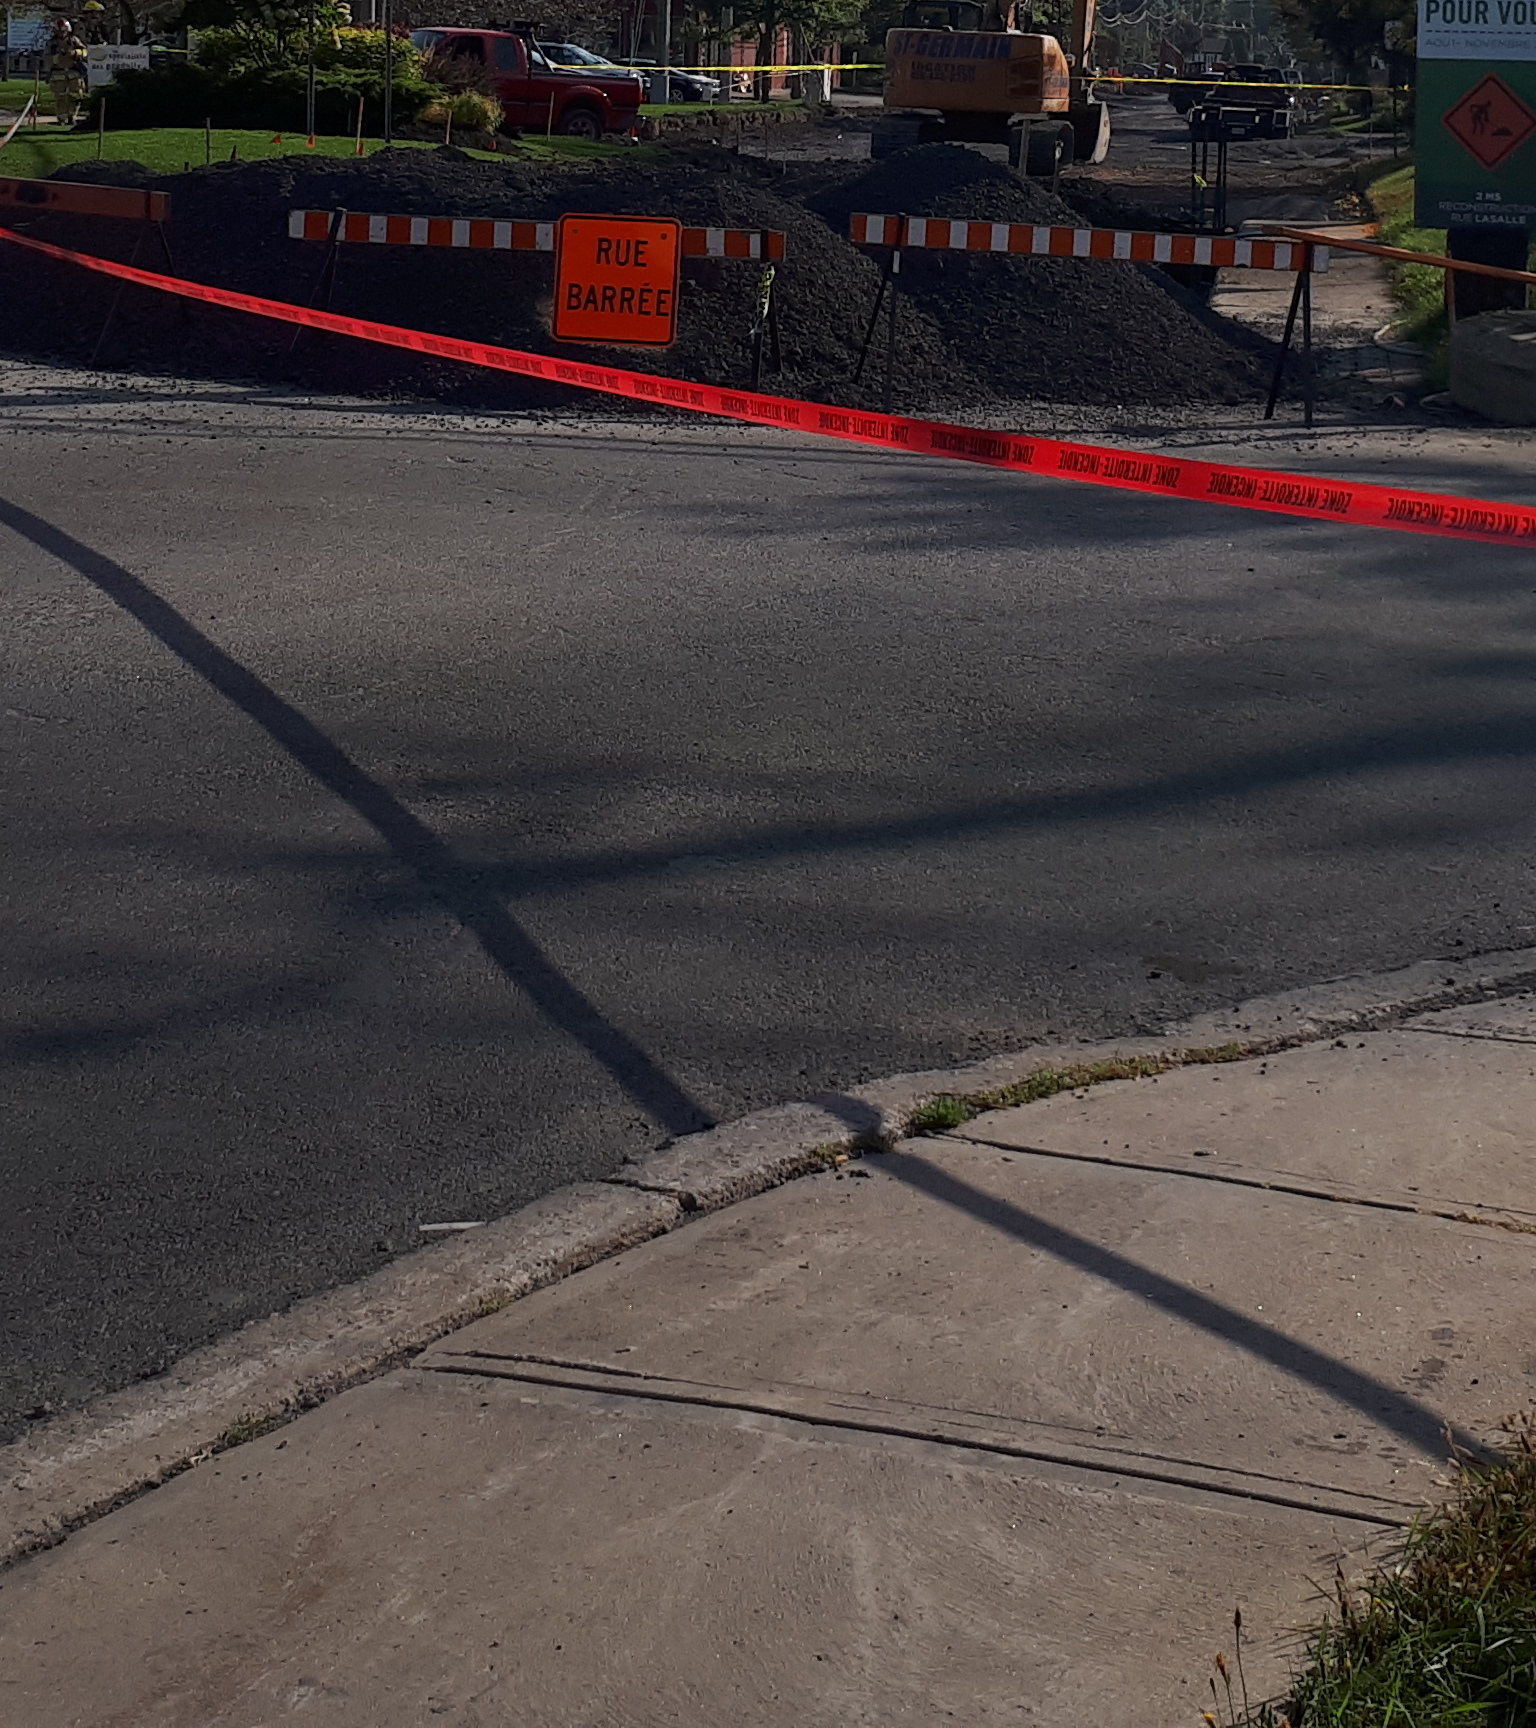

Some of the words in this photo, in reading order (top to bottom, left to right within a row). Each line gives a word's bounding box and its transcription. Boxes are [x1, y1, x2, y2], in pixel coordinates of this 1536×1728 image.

[1425, 0, 1488, 24] POUR
[893, 32, 1011, 59] ST-GERMAIN
[1475, 214, 1526, 224] LASALLE
[596, 237, 649, 267] RUE
[567, 282, 671, 317] BARRÉE
[1151, 461, 1182, 488] ZONE
[1318, 488, 1354, 514] ZONE
